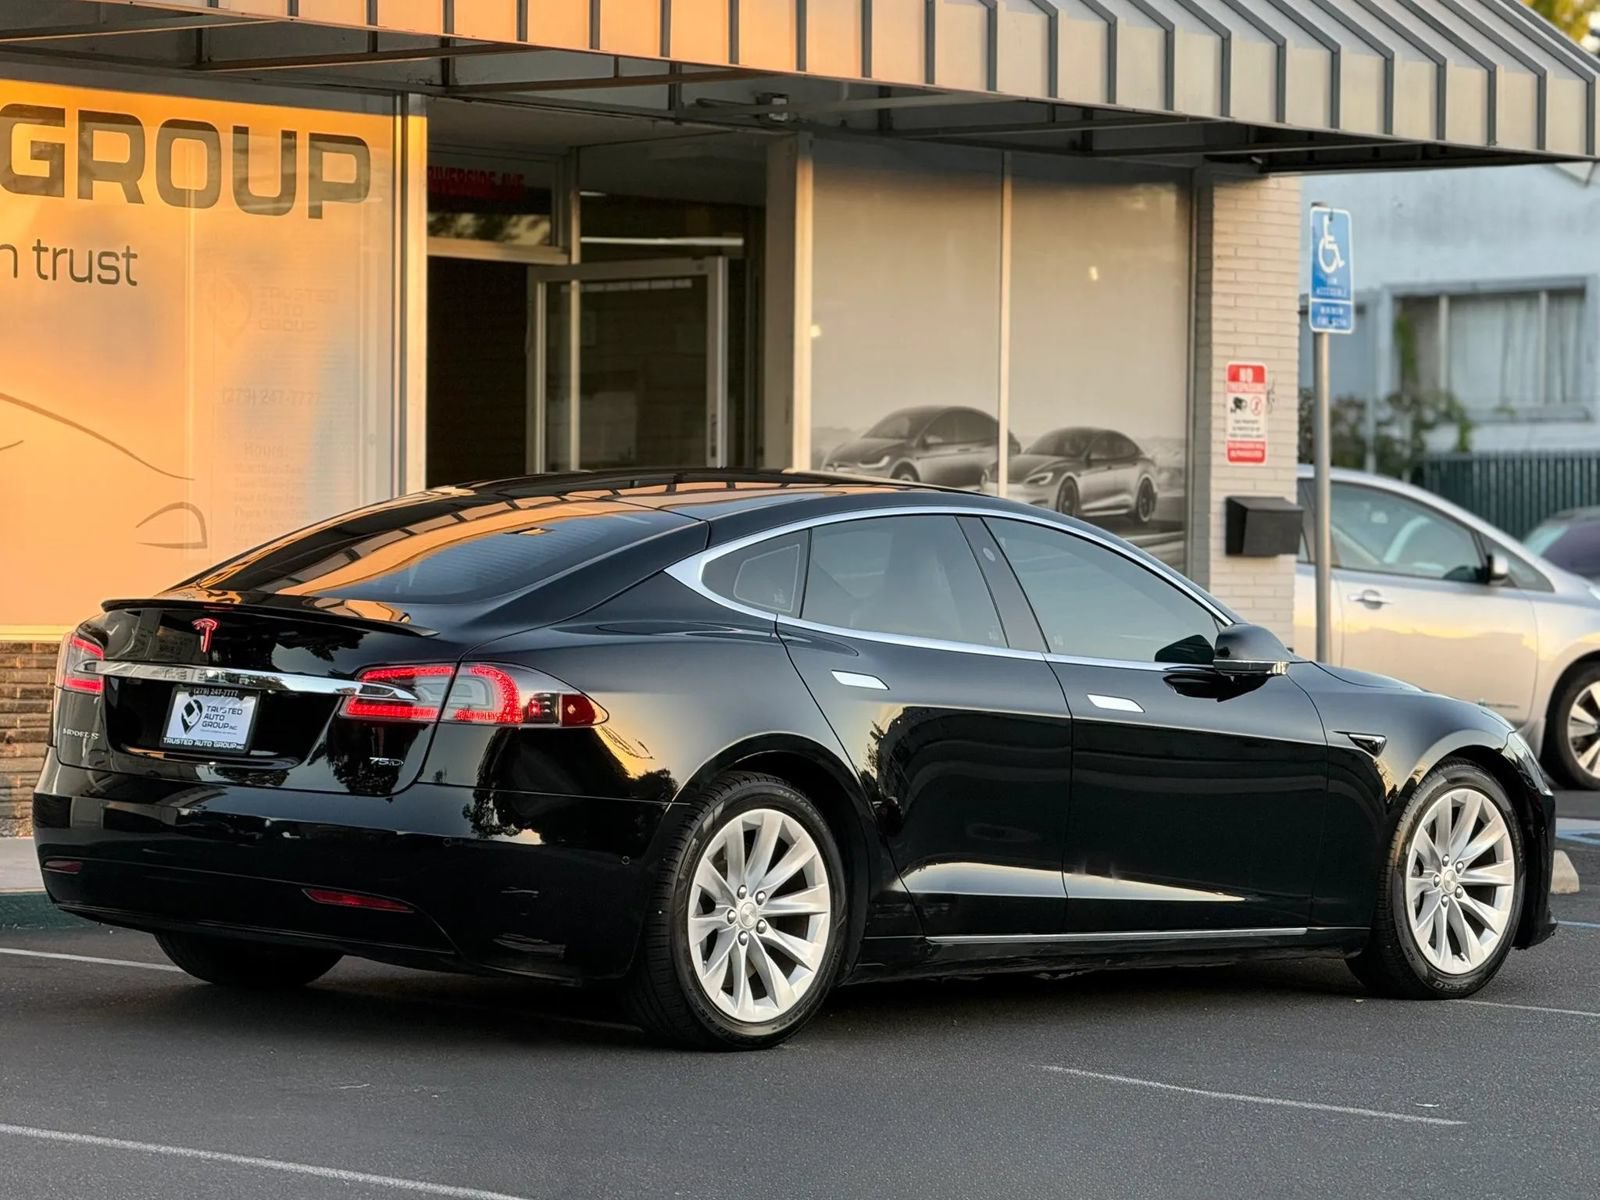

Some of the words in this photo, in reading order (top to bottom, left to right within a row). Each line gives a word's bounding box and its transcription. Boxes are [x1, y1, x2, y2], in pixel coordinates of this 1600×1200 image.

[0, 103, 371, 219] GROUP
[32, 239, 138, 286] trust
[206, 705, 243, 716] TRUSTED
[203, 713, 225, 721] AUTO
[201, 720, 229, 729] GROUP
[163, 737, 193, 746] TRUSTED
[193, 739, 212, 747] AUTO
[213, 741, 237, 749] GROUP
